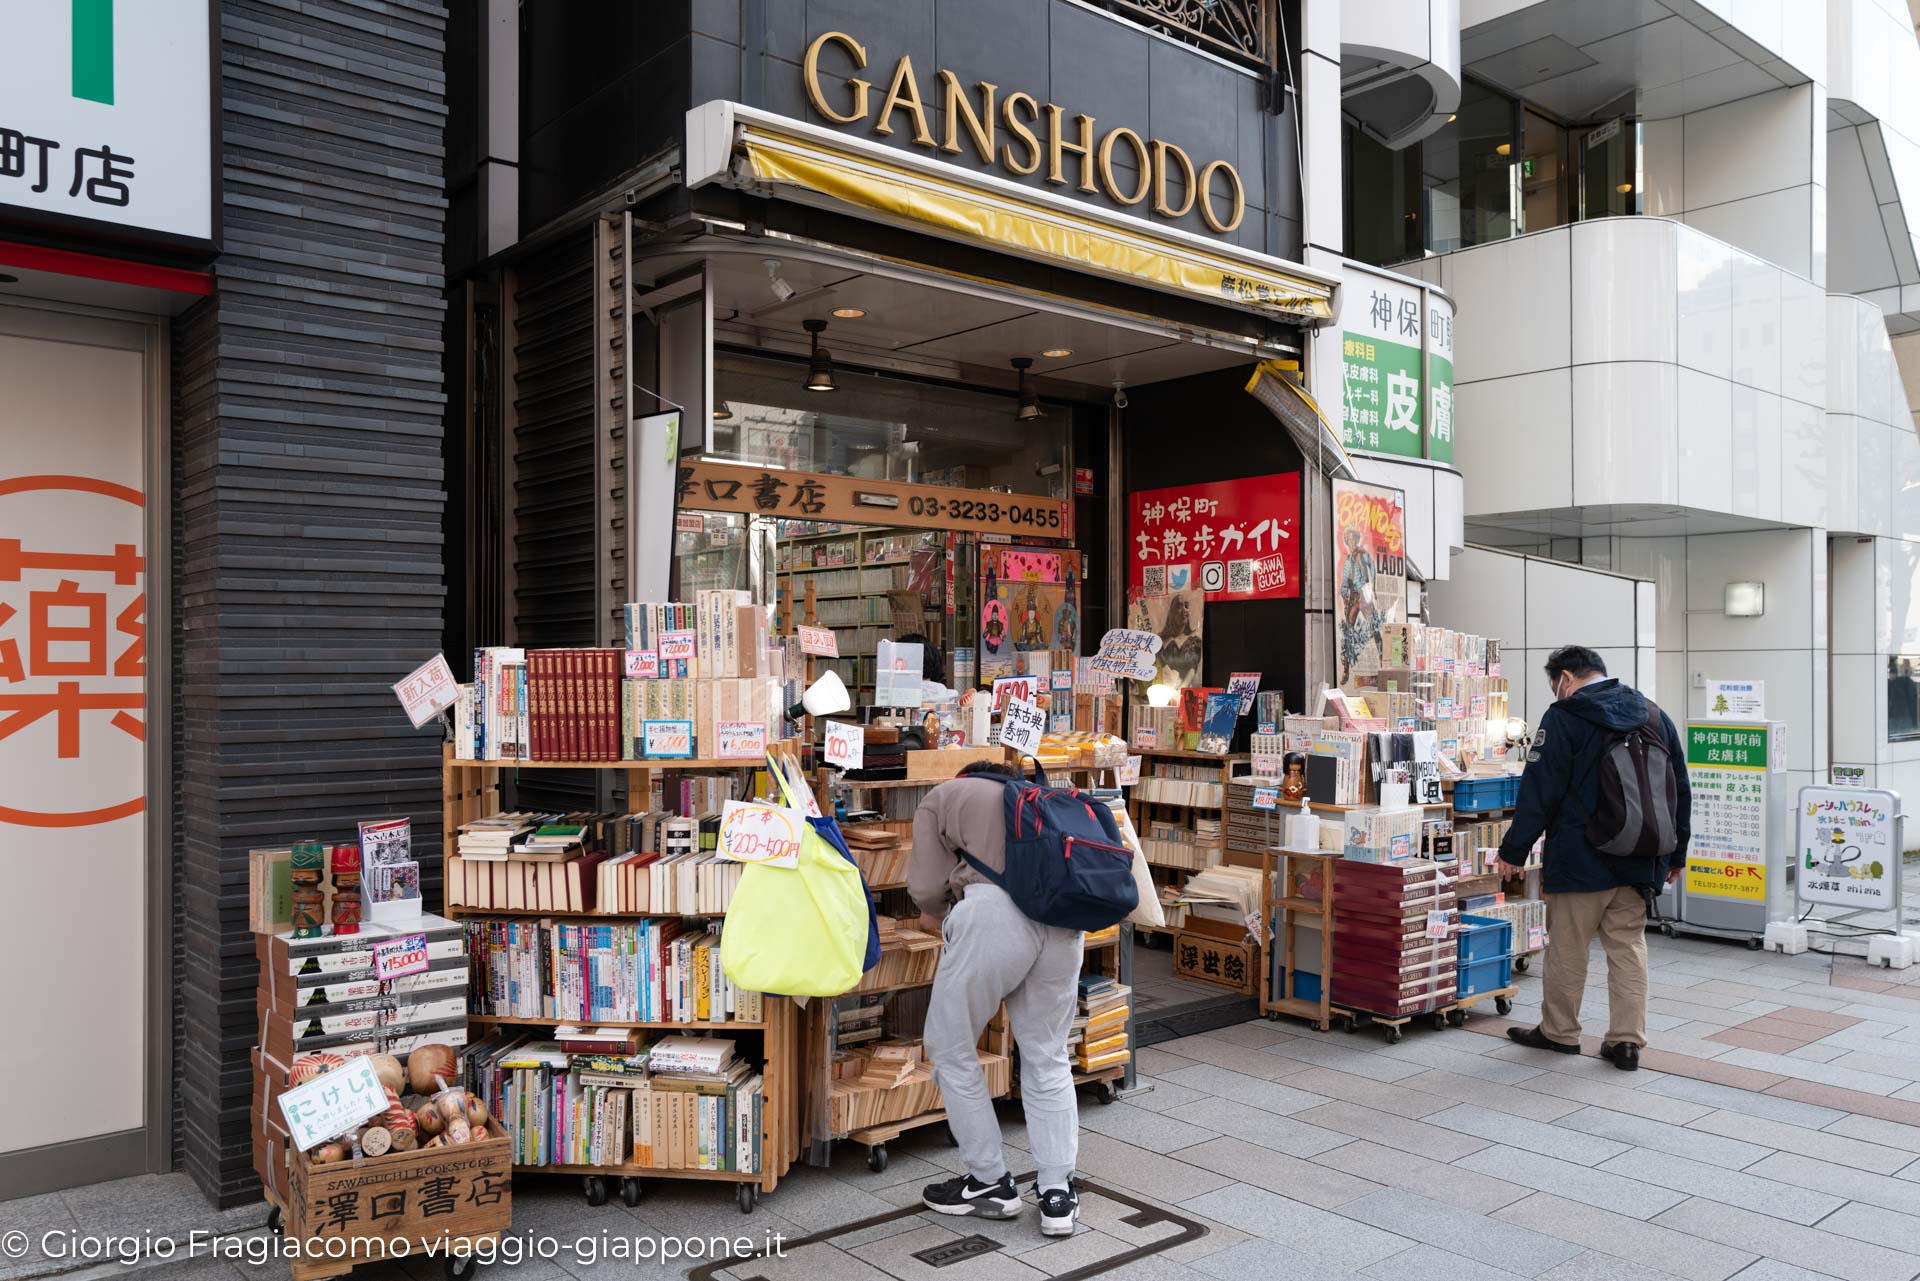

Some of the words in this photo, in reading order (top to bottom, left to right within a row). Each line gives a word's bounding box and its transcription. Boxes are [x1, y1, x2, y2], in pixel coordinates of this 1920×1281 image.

[803, 31, 1245, 233] GANSHODO
[908, 496, 1060, 529] 03-3233-0455
[1141, 496, 1219, 526] 神保町
[1136, 518, 1292, 561] お散歩ガイド
[1258, 556, 1283, 575] SAWA
[1259, 570, 1286, 589] GUCHI
[1376, 553, 1404, 577] LADD
[402, 666, 443, 701] 新入荷
[1008, 703, 1043, 731] 日本古典
[1004, 720, 1030, 747] 巻物
[1693, 731, 1761, 747] 神保町駅前
[1708, 748, 1748, 763] 皮膚科
[1724, 865, 1744, 878] 6F
[382, 951, 425, 972] ¥15,000
[1181, 943, 1245, 982] 浮世絵
[299, 1078, 366, 1117] こけし
[327, 1170, 410, 1191] SAWAGUCHI
[415, 1157, 496, 1177] BOOKSTORE
[315, 1171, 504, 1235] 澤口書店
